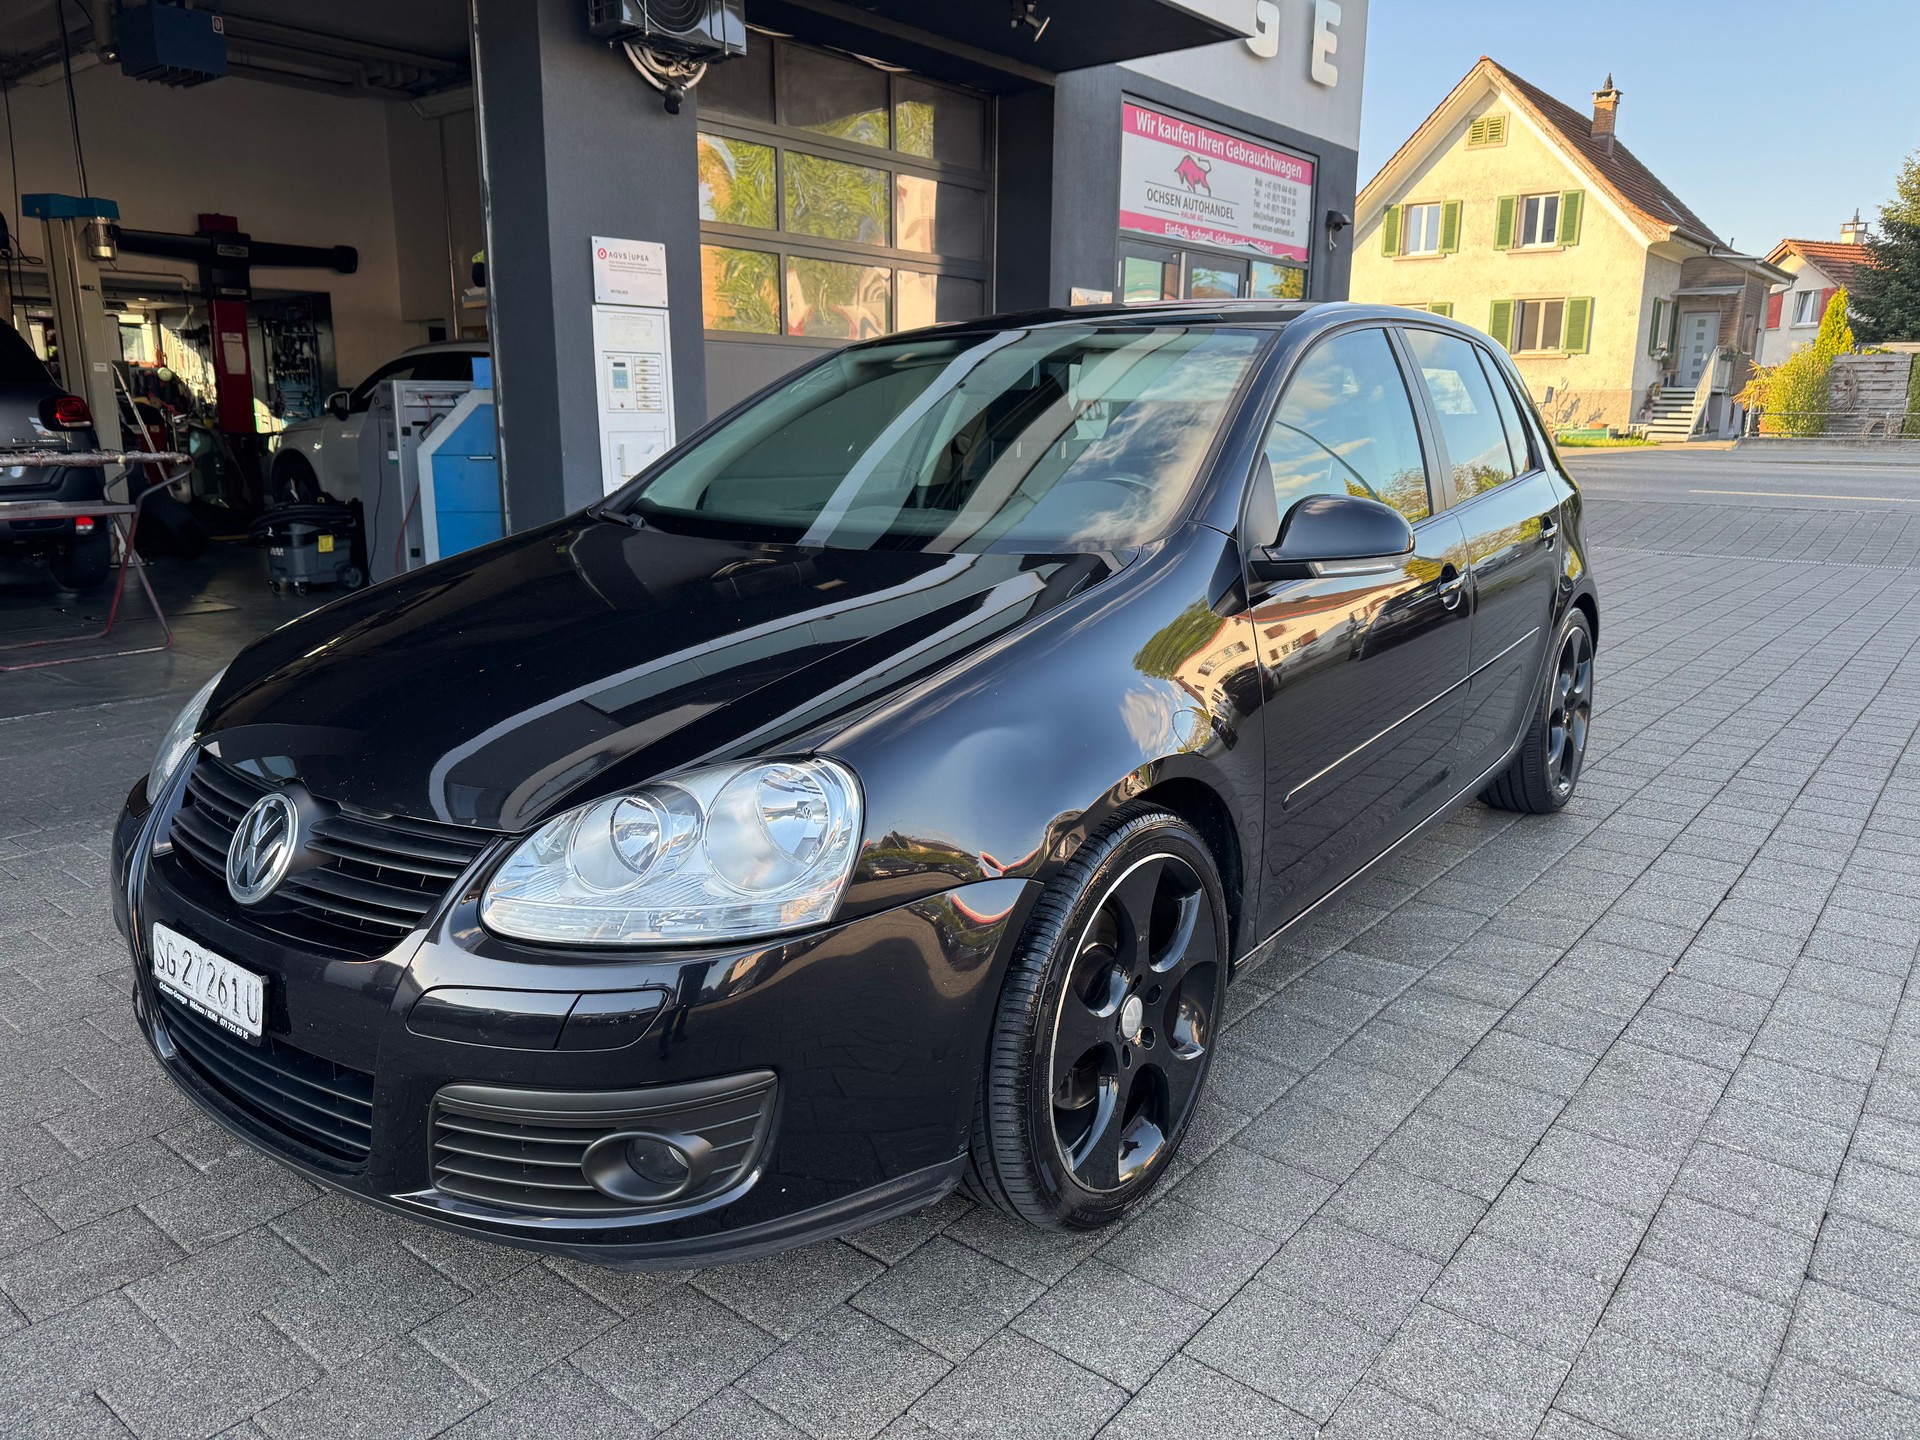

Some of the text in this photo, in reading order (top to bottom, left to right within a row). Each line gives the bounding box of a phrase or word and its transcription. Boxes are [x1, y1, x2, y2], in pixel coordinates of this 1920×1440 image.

[1136, 111, 1302, 179] Wir kaufen Ihren Gebrauchtwagen
[1146, 188, 1235, 220] OCHSEN AUTOHANDEL
[1164, 222, 1190, 240] Einfach,
[609, 251, 649, 262] AGVS UPSA
[157, 933, 177, 978] SG
